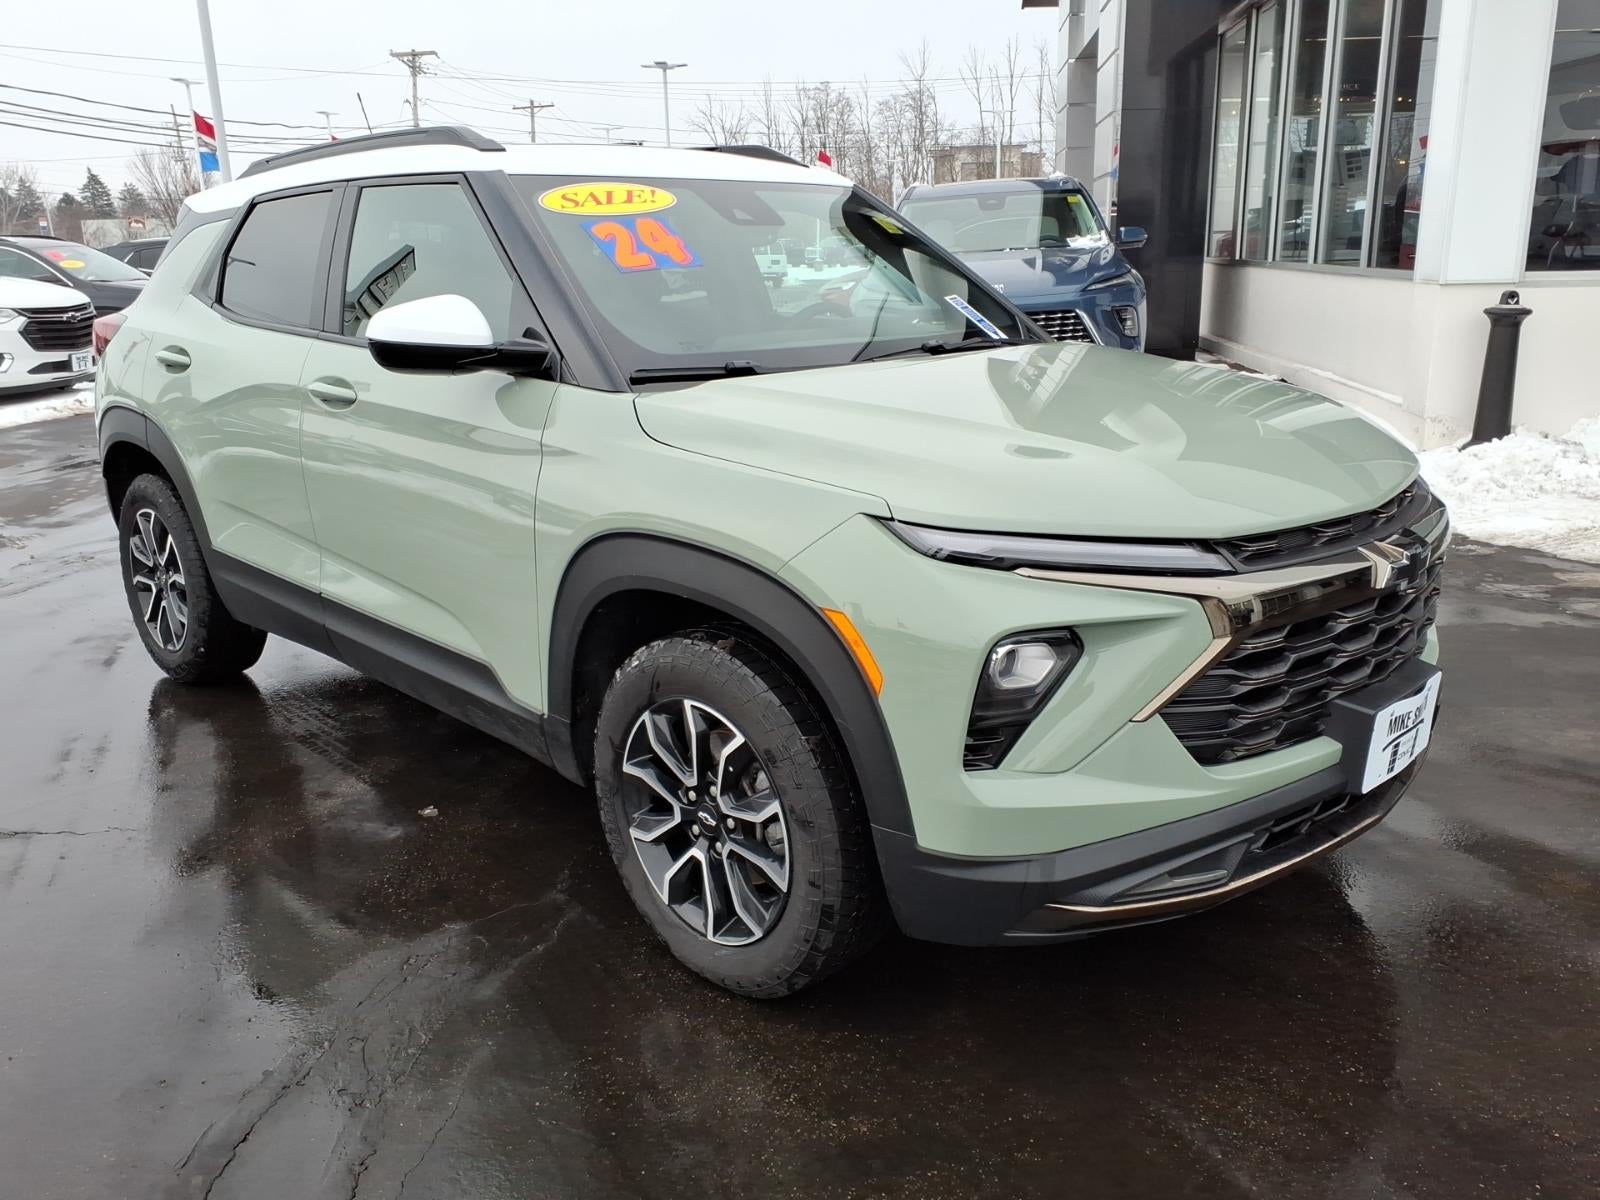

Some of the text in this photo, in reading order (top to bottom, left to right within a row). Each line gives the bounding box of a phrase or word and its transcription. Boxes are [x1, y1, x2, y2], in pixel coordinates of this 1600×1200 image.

[560, 189, 657, 209] SALE!
[591, 217, 694, 270] 24
[1387, 710, 1413, 737] MIKE
